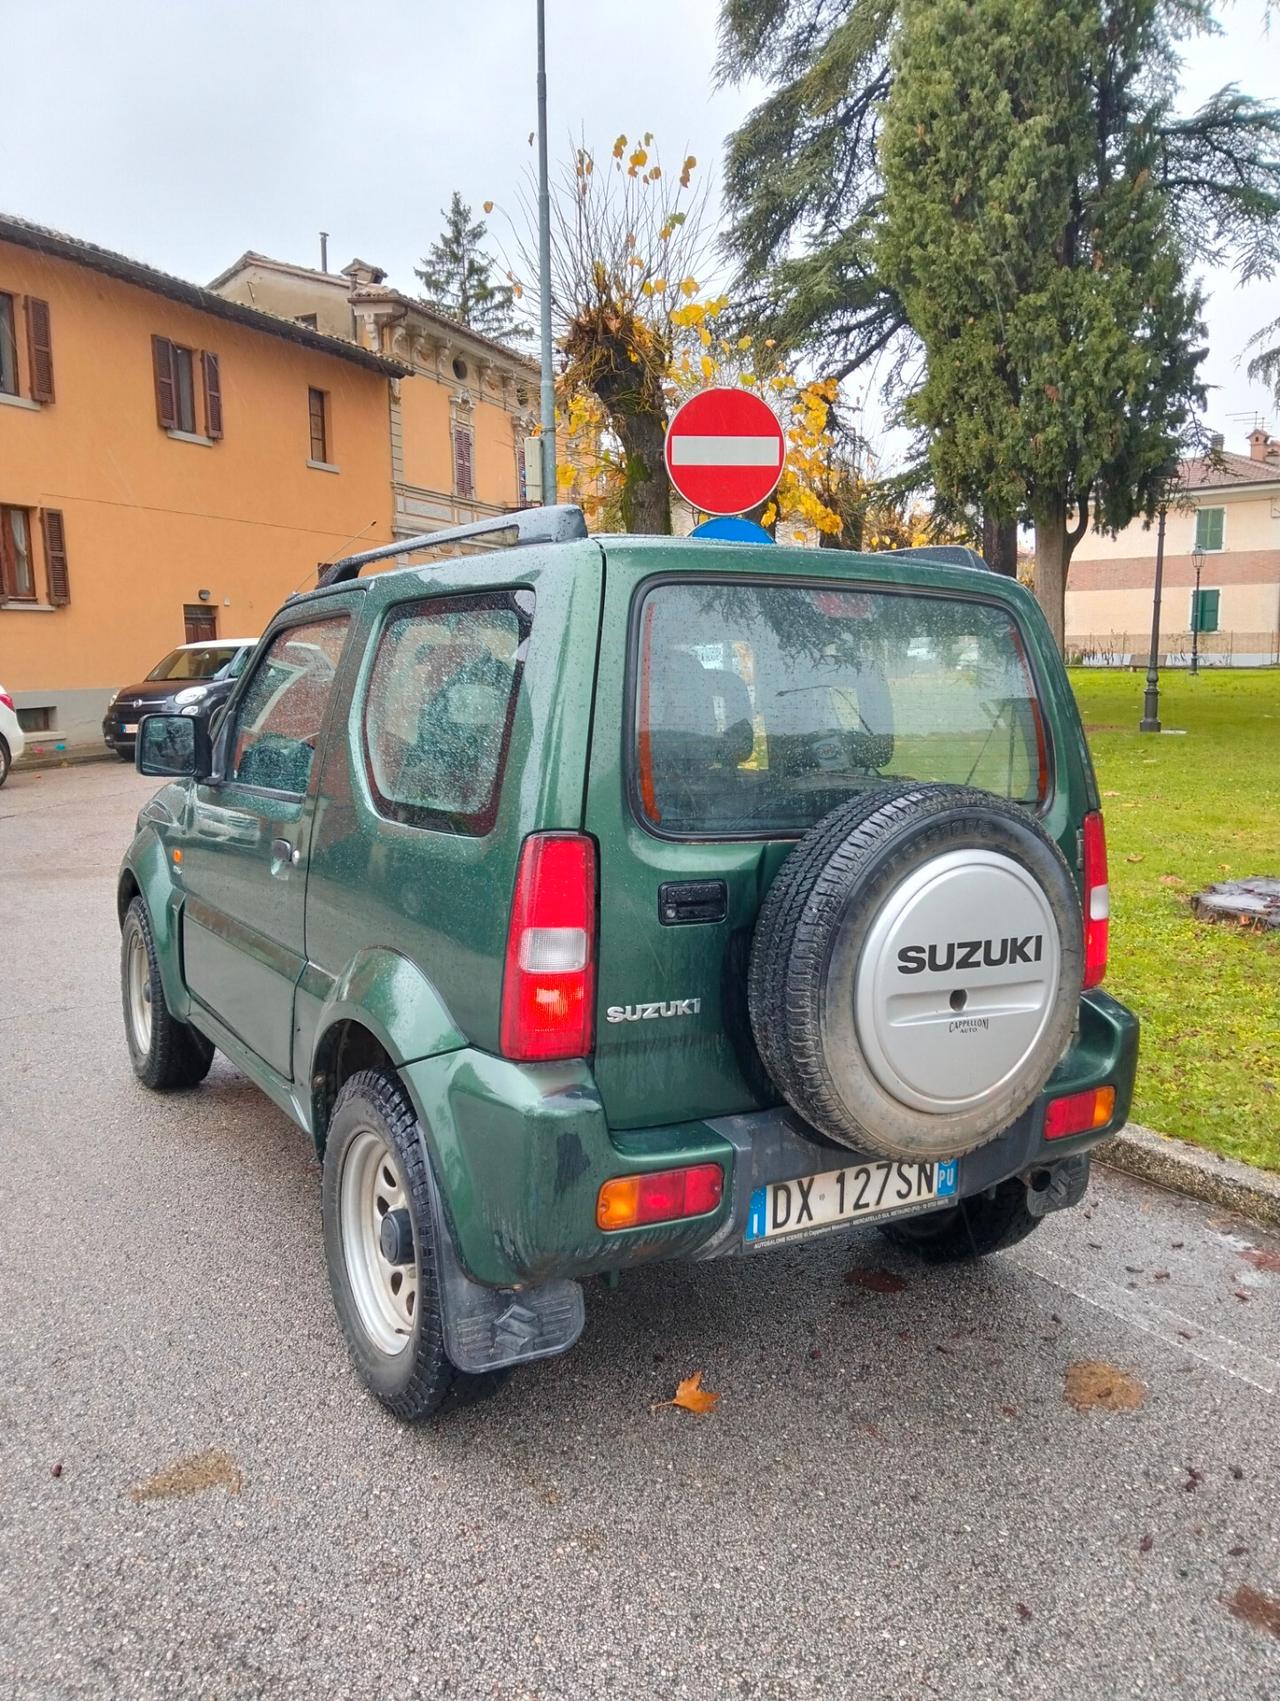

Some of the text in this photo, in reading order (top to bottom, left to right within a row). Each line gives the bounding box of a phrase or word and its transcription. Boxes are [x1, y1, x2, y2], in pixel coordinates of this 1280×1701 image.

[897, 935, 1043, 975] SUZUKI
[606, 998, 702, 1023] SUZUKI
[772, 1177, 815, 1230] DX
[836, 1162, 935, 1215] 127SN
[937, 1168, 954, 1189] PU
